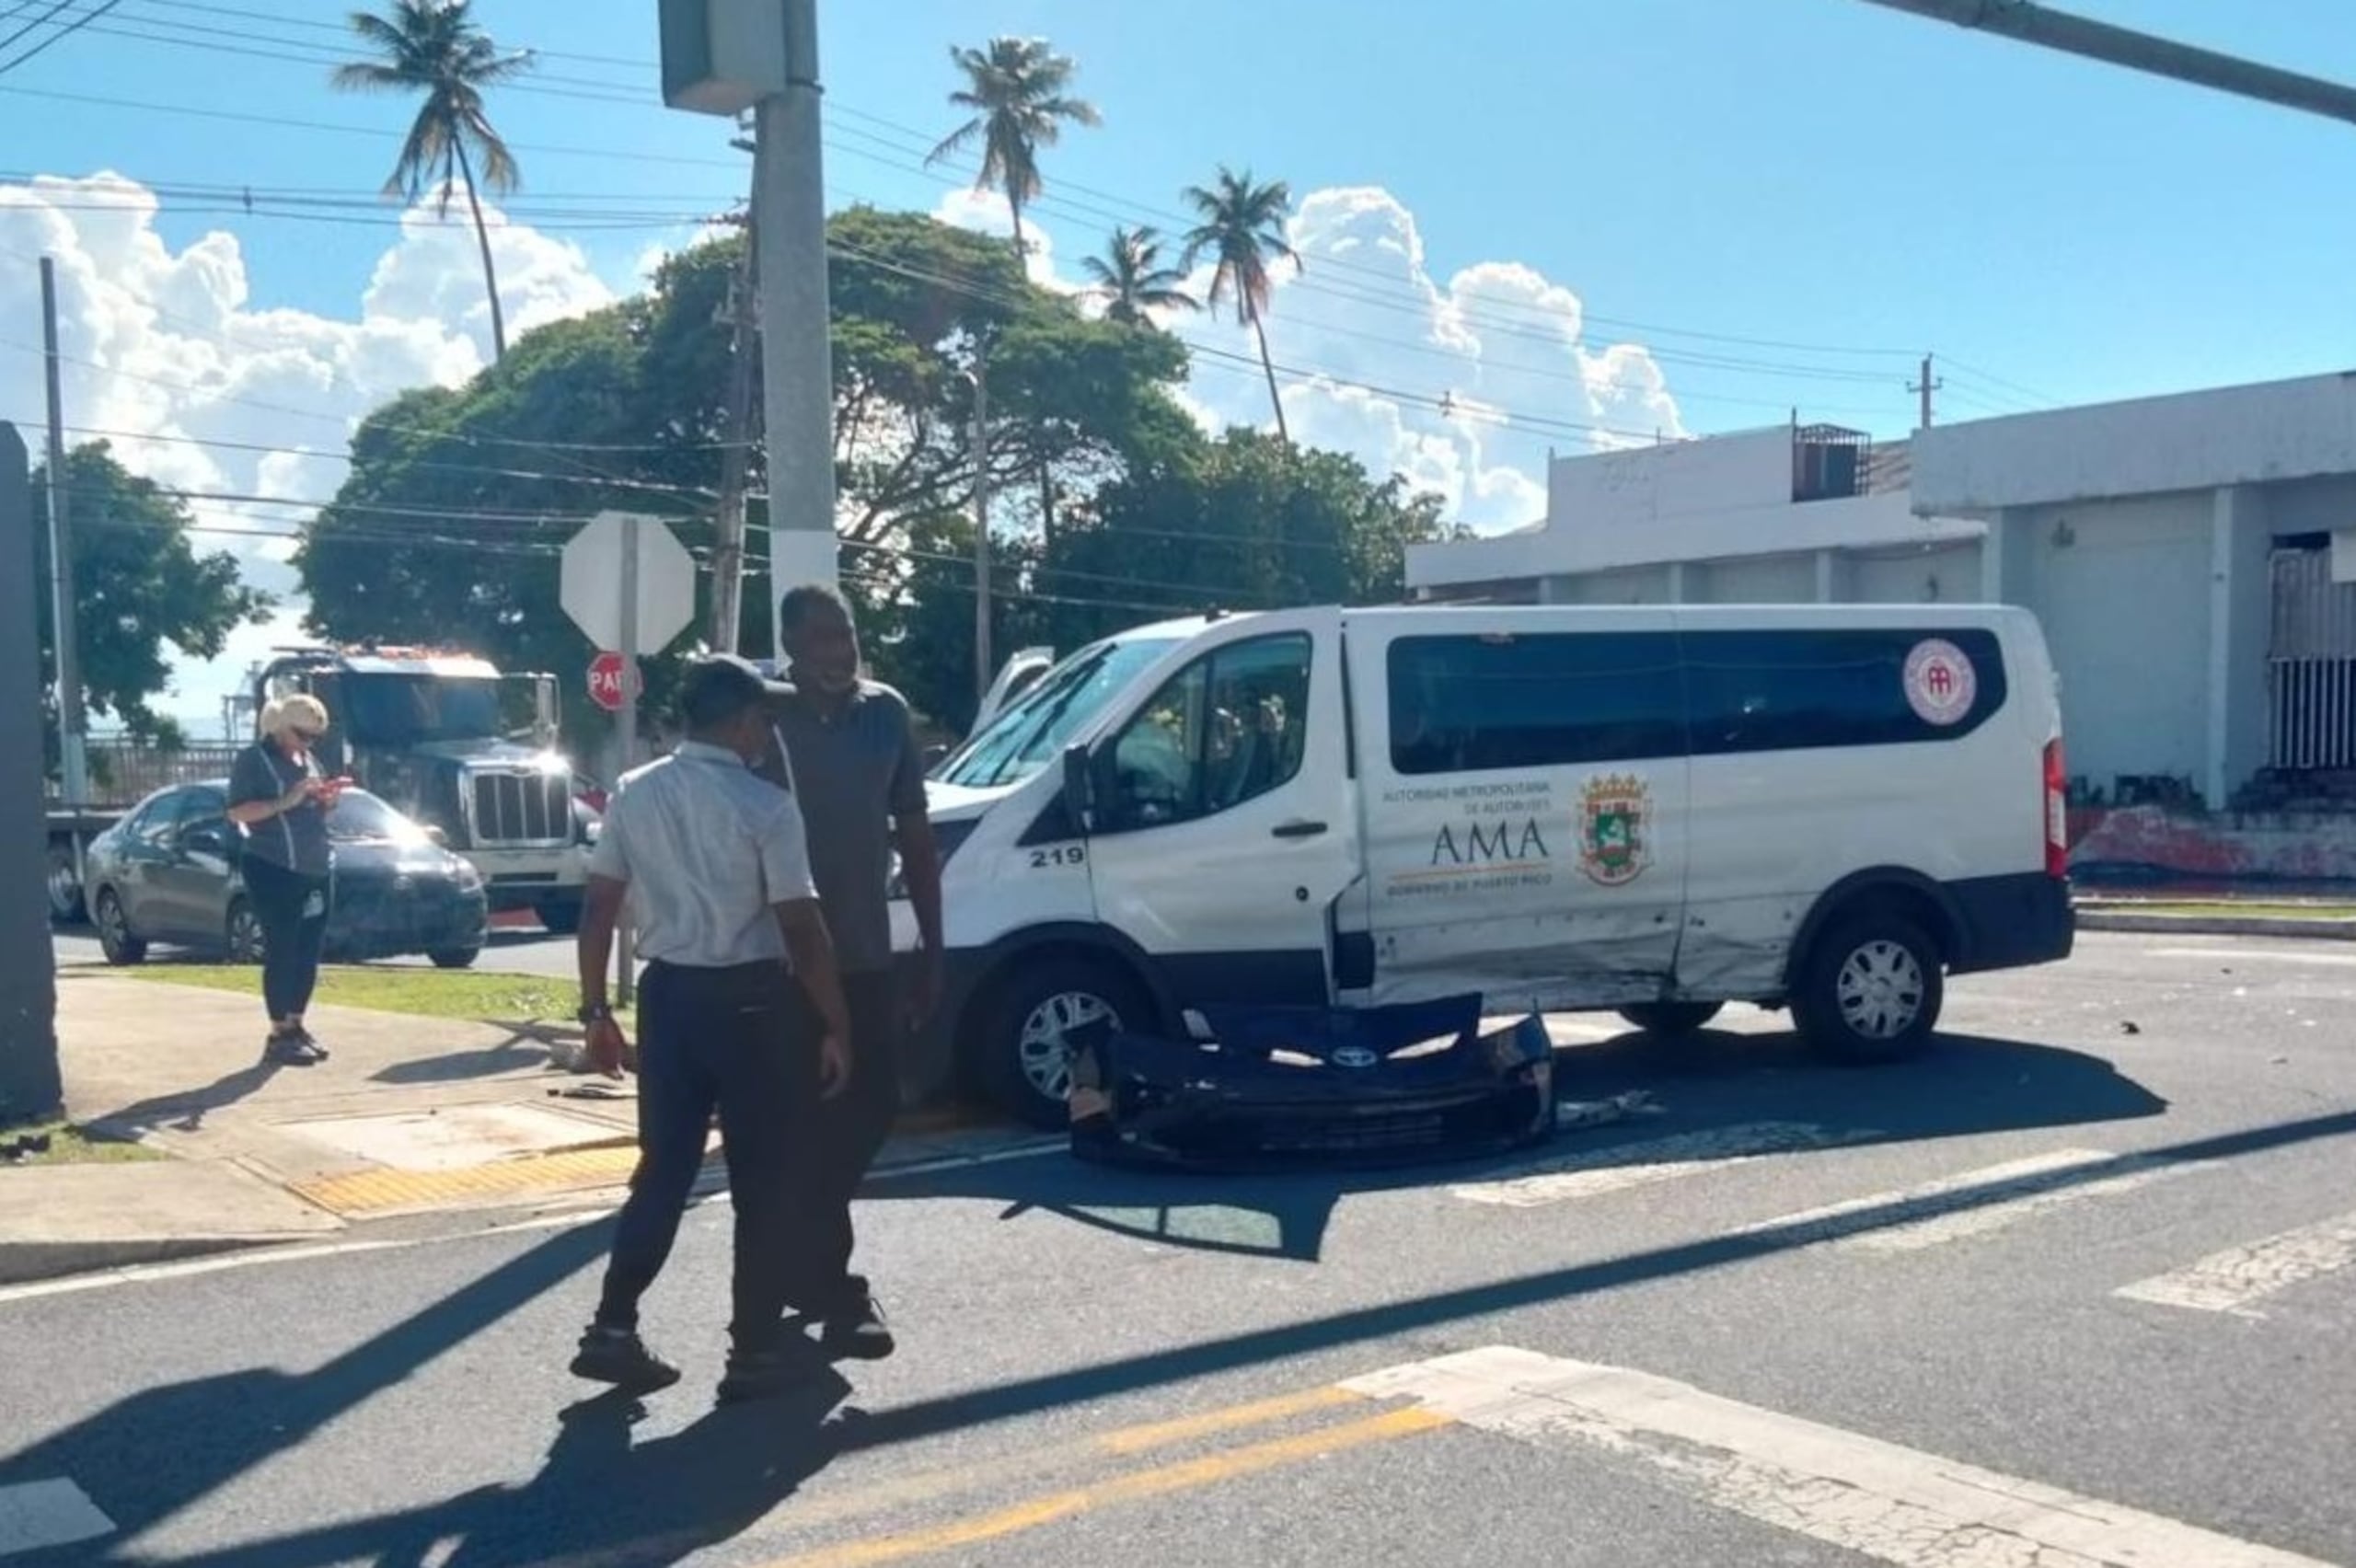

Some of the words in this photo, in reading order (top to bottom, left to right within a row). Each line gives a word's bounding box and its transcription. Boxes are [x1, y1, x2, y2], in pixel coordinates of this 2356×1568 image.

[590, 671, 626, 692] PAR
[1431, 817, 1549, 865] AMA
[1030, 847, 1084, 868] 219
